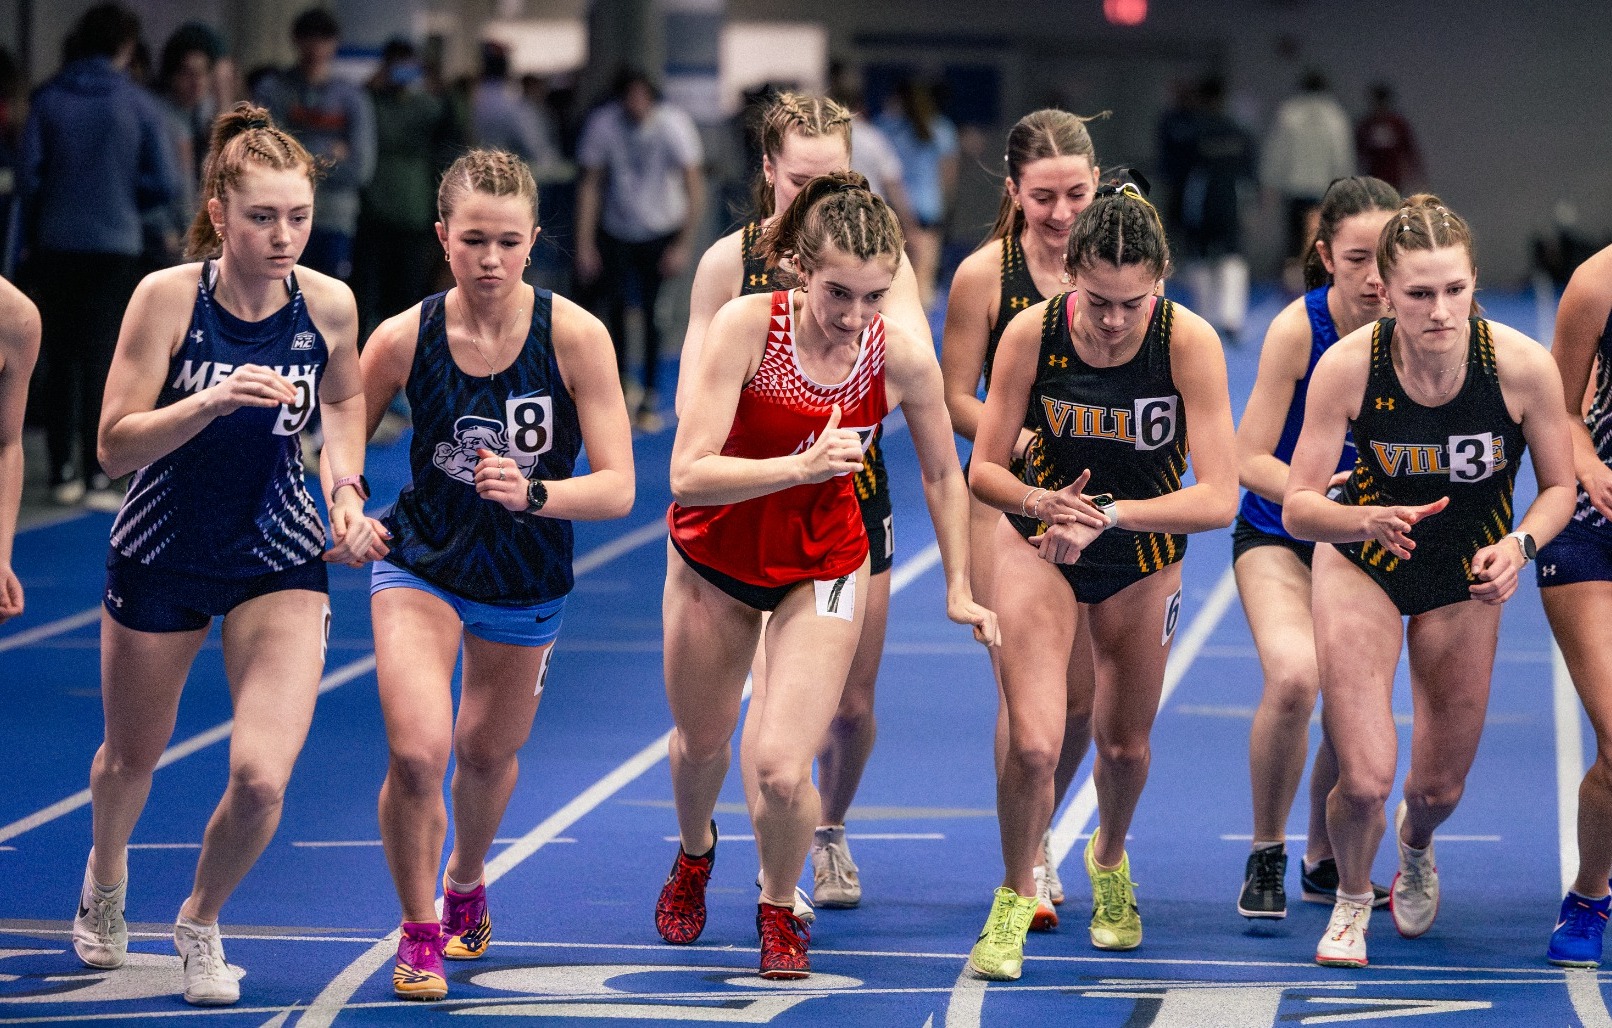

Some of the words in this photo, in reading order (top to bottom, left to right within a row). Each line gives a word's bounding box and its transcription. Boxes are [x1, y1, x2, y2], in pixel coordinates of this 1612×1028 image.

[283, 380, 310, 431] 9
[514, 402, 547, 453] 8
[1041, 395, 1136, 444] VILL
[1142, 401, 1170, 446] 6
[1370, 436, 1507, 477] VILE
[1456, 439, 1486, 480] 3
[1166, 590, 1180, 636] 6
